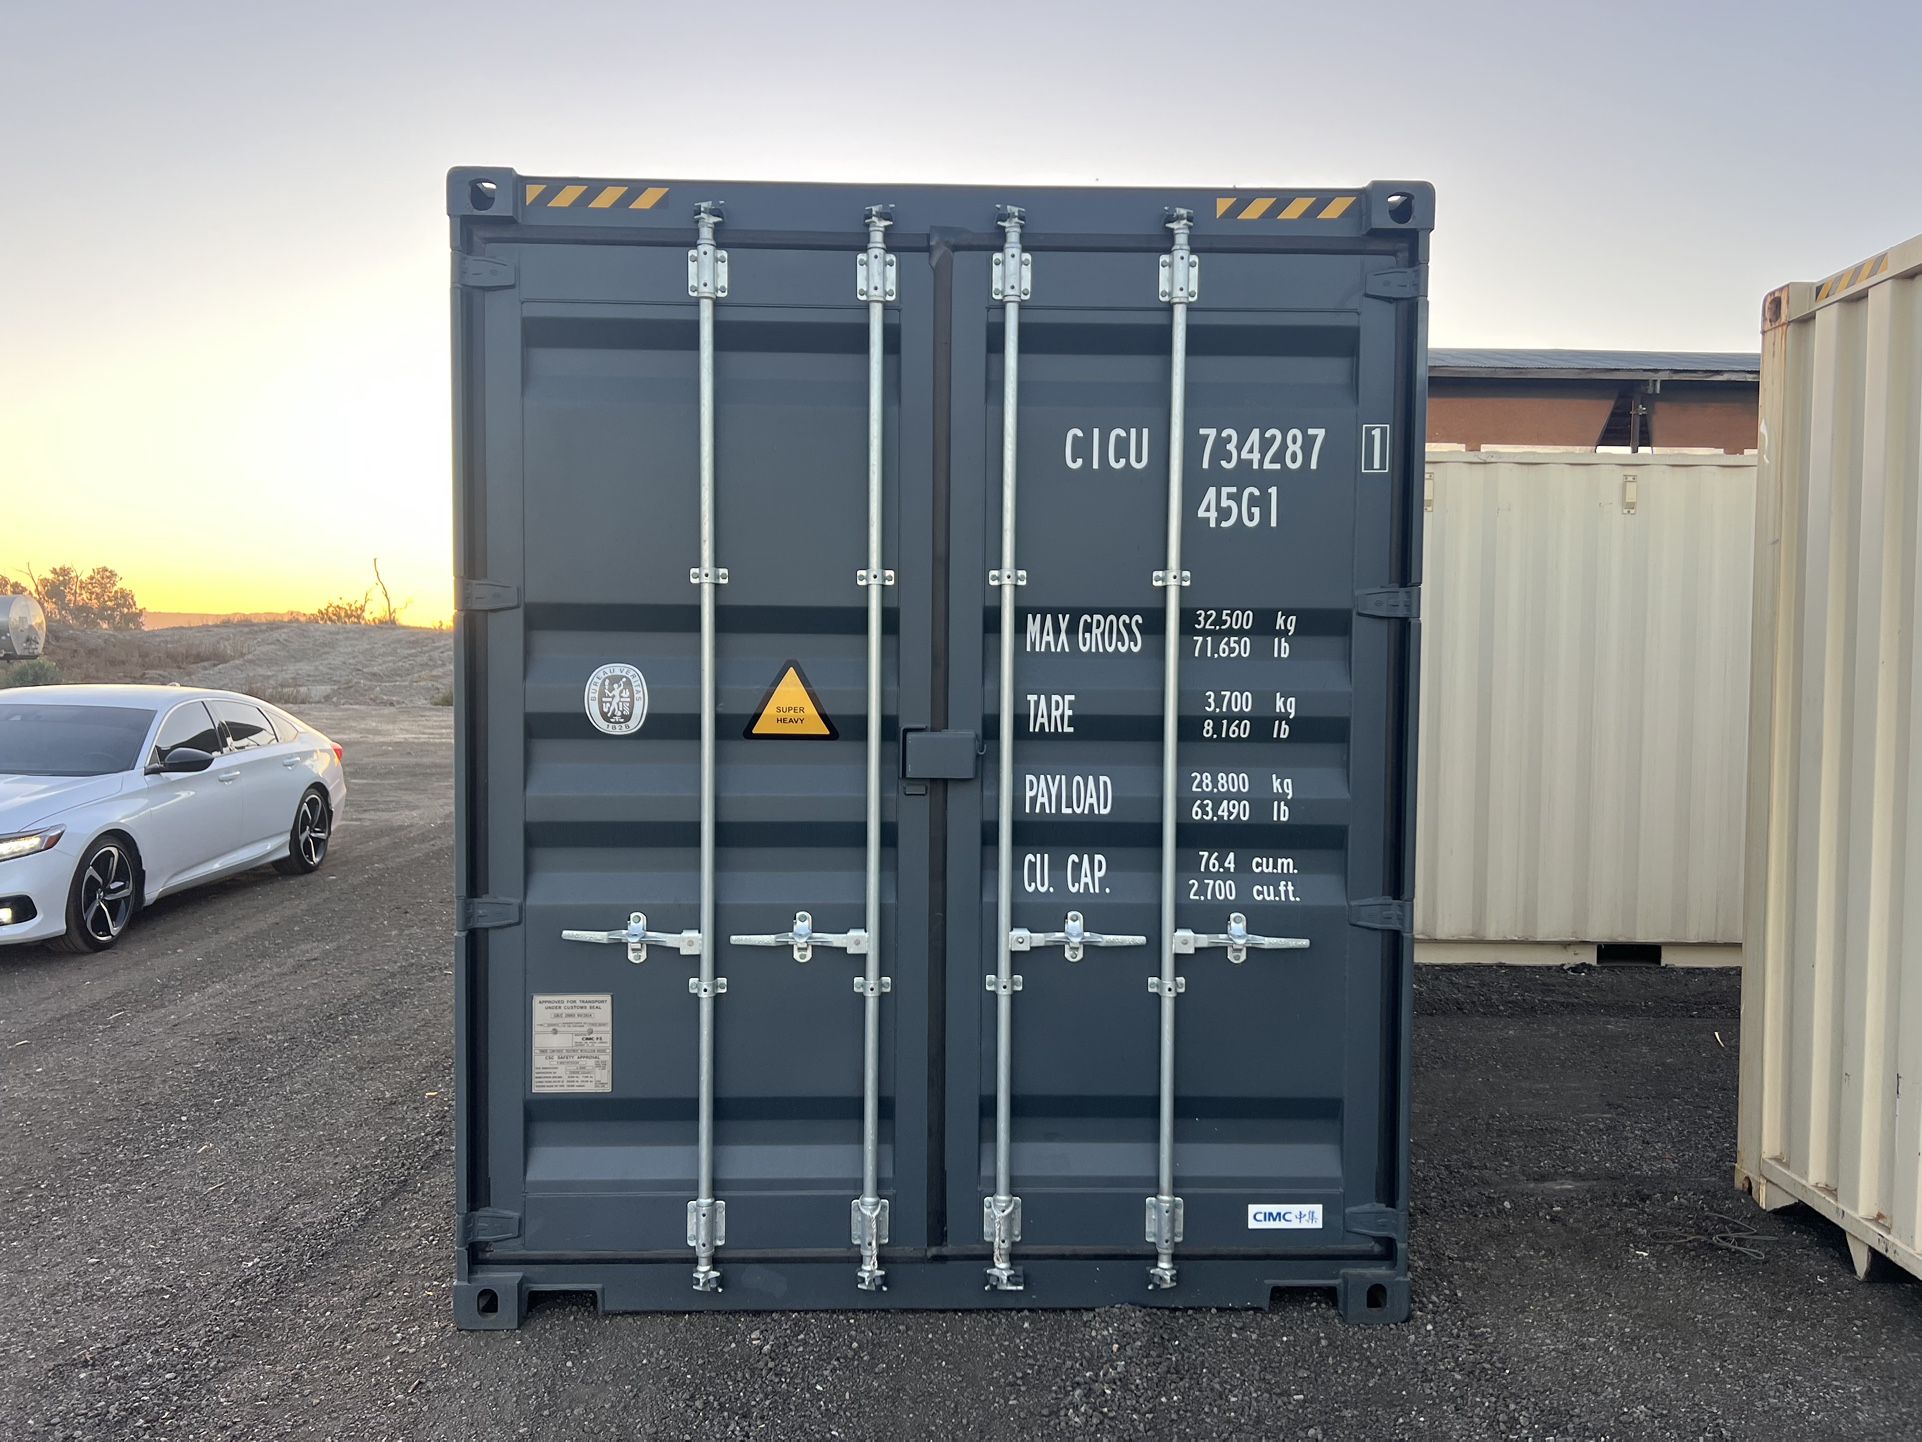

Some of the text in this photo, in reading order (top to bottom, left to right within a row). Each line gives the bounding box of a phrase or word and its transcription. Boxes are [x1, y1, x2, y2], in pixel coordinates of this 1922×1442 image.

[1065, 427, 1381, 470] CICU 734287 1
[1197, 486, 1279, 528] 45G1
[1026, 613, 1070, 653] MAX
[1078, 613, 1143, 653] GROSS
[1275, 610, 1297, 636] kg
[1192, 636, 1290, 659] 71,650 lb
[590, 668, 642, 702] BUREAU VERITAS
[775, 706, 805, 714] SUPER
[1026, 694, 1075, 733] TARE
[1275, 691, 1296, 720] kg
[1272, 719, 1290, 739] lb
[1025, 774, 1112, 815] PAYLOAD
[1271, 773, 1293, 800] kg
[1272, 800, 1290, 822] lb
[1023, 853, 1054, 893] CU.
[1066, 853, 1111, 894] CAP.
[1198, 851, 1236, 873] 76.4
[1253, 1211, 1292, 1223] CIMC
